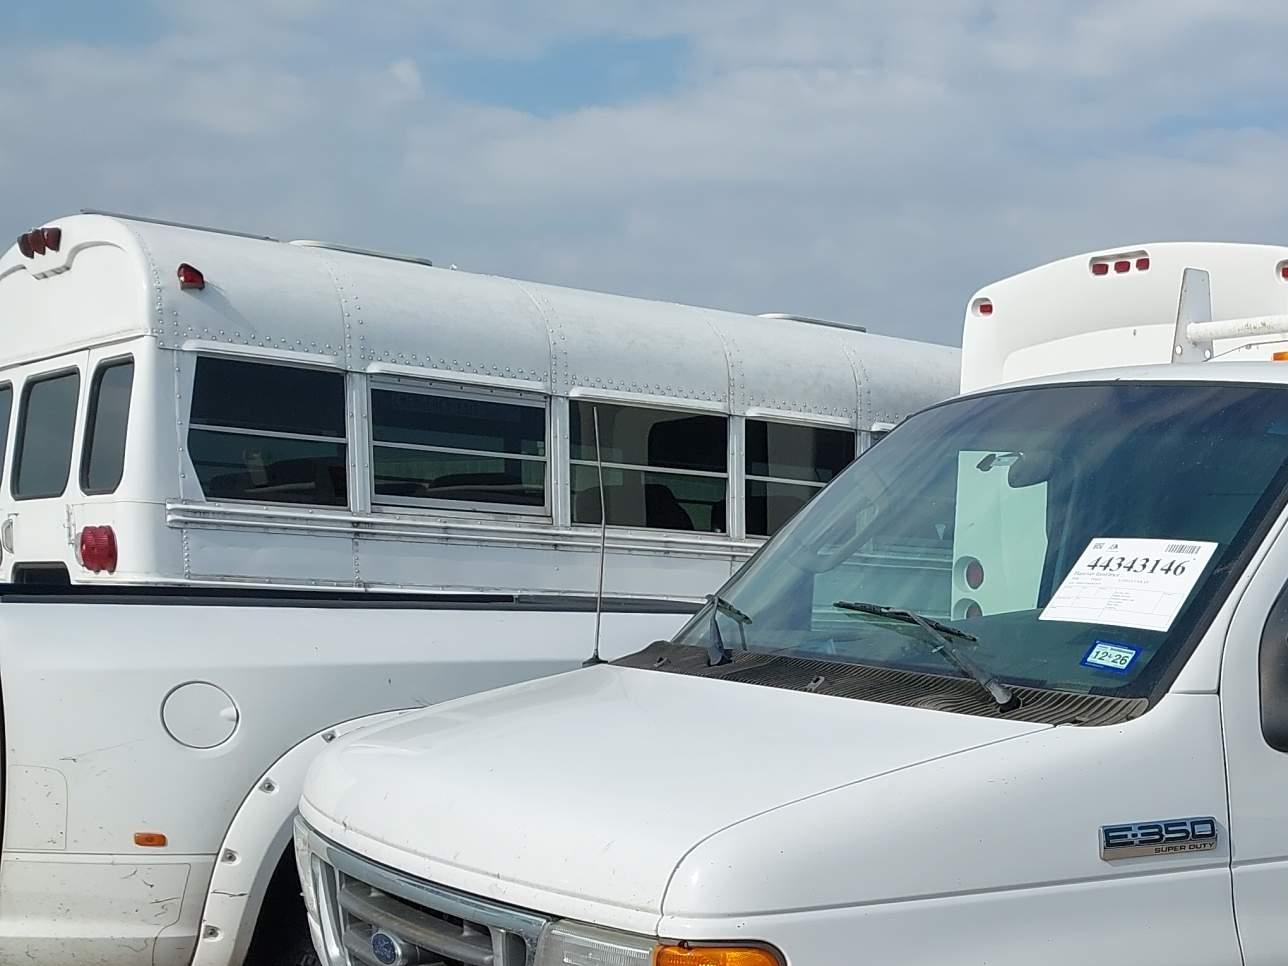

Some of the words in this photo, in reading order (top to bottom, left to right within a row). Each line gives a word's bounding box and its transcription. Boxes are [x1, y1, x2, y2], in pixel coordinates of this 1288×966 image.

[1086, 555, 1190, 577] 44343146
[1092, 650, 1109, 661] 12
[1111, 654, 1130, 665] 26
[1154, 845, 1186, 854] SUPER
[1188, 842, 1215, 850] DUTY
